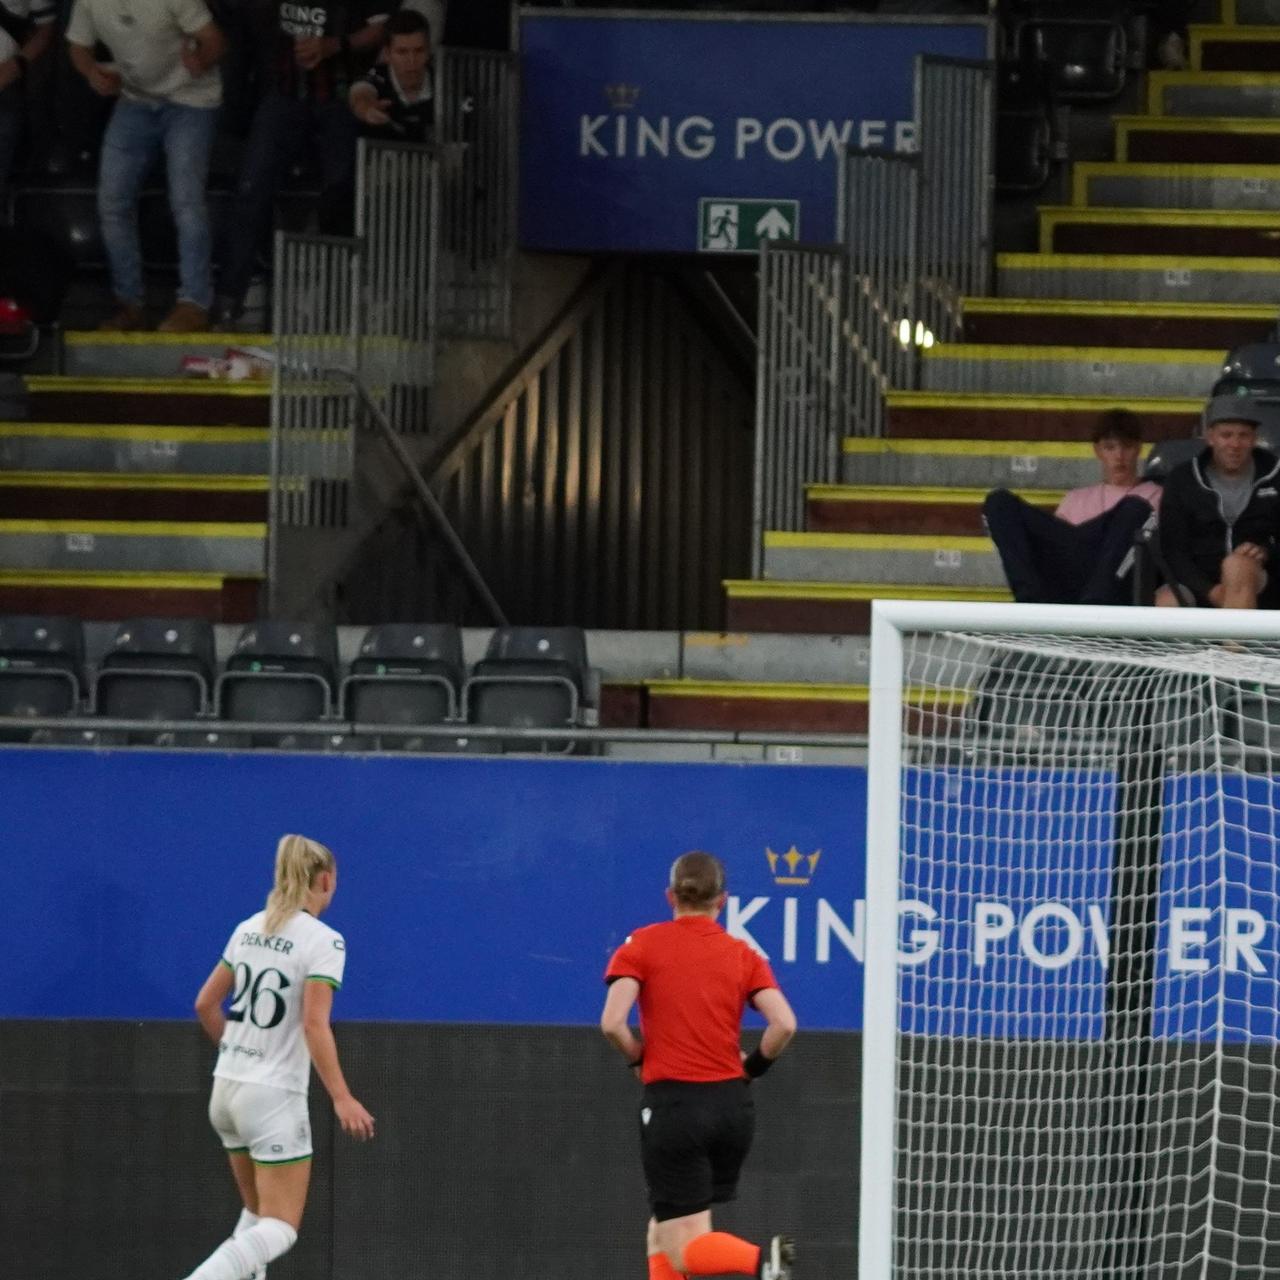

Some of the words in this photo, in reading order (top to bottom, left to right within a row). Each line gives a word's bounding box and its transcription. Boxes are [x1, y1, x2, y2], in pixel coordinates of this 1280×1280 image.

[579, 114, 716, 159] KING
[735, 117, 918, 161] POWER
[974, 902, 1267, 974] POER
[227, 961, 291, 1029] 26
